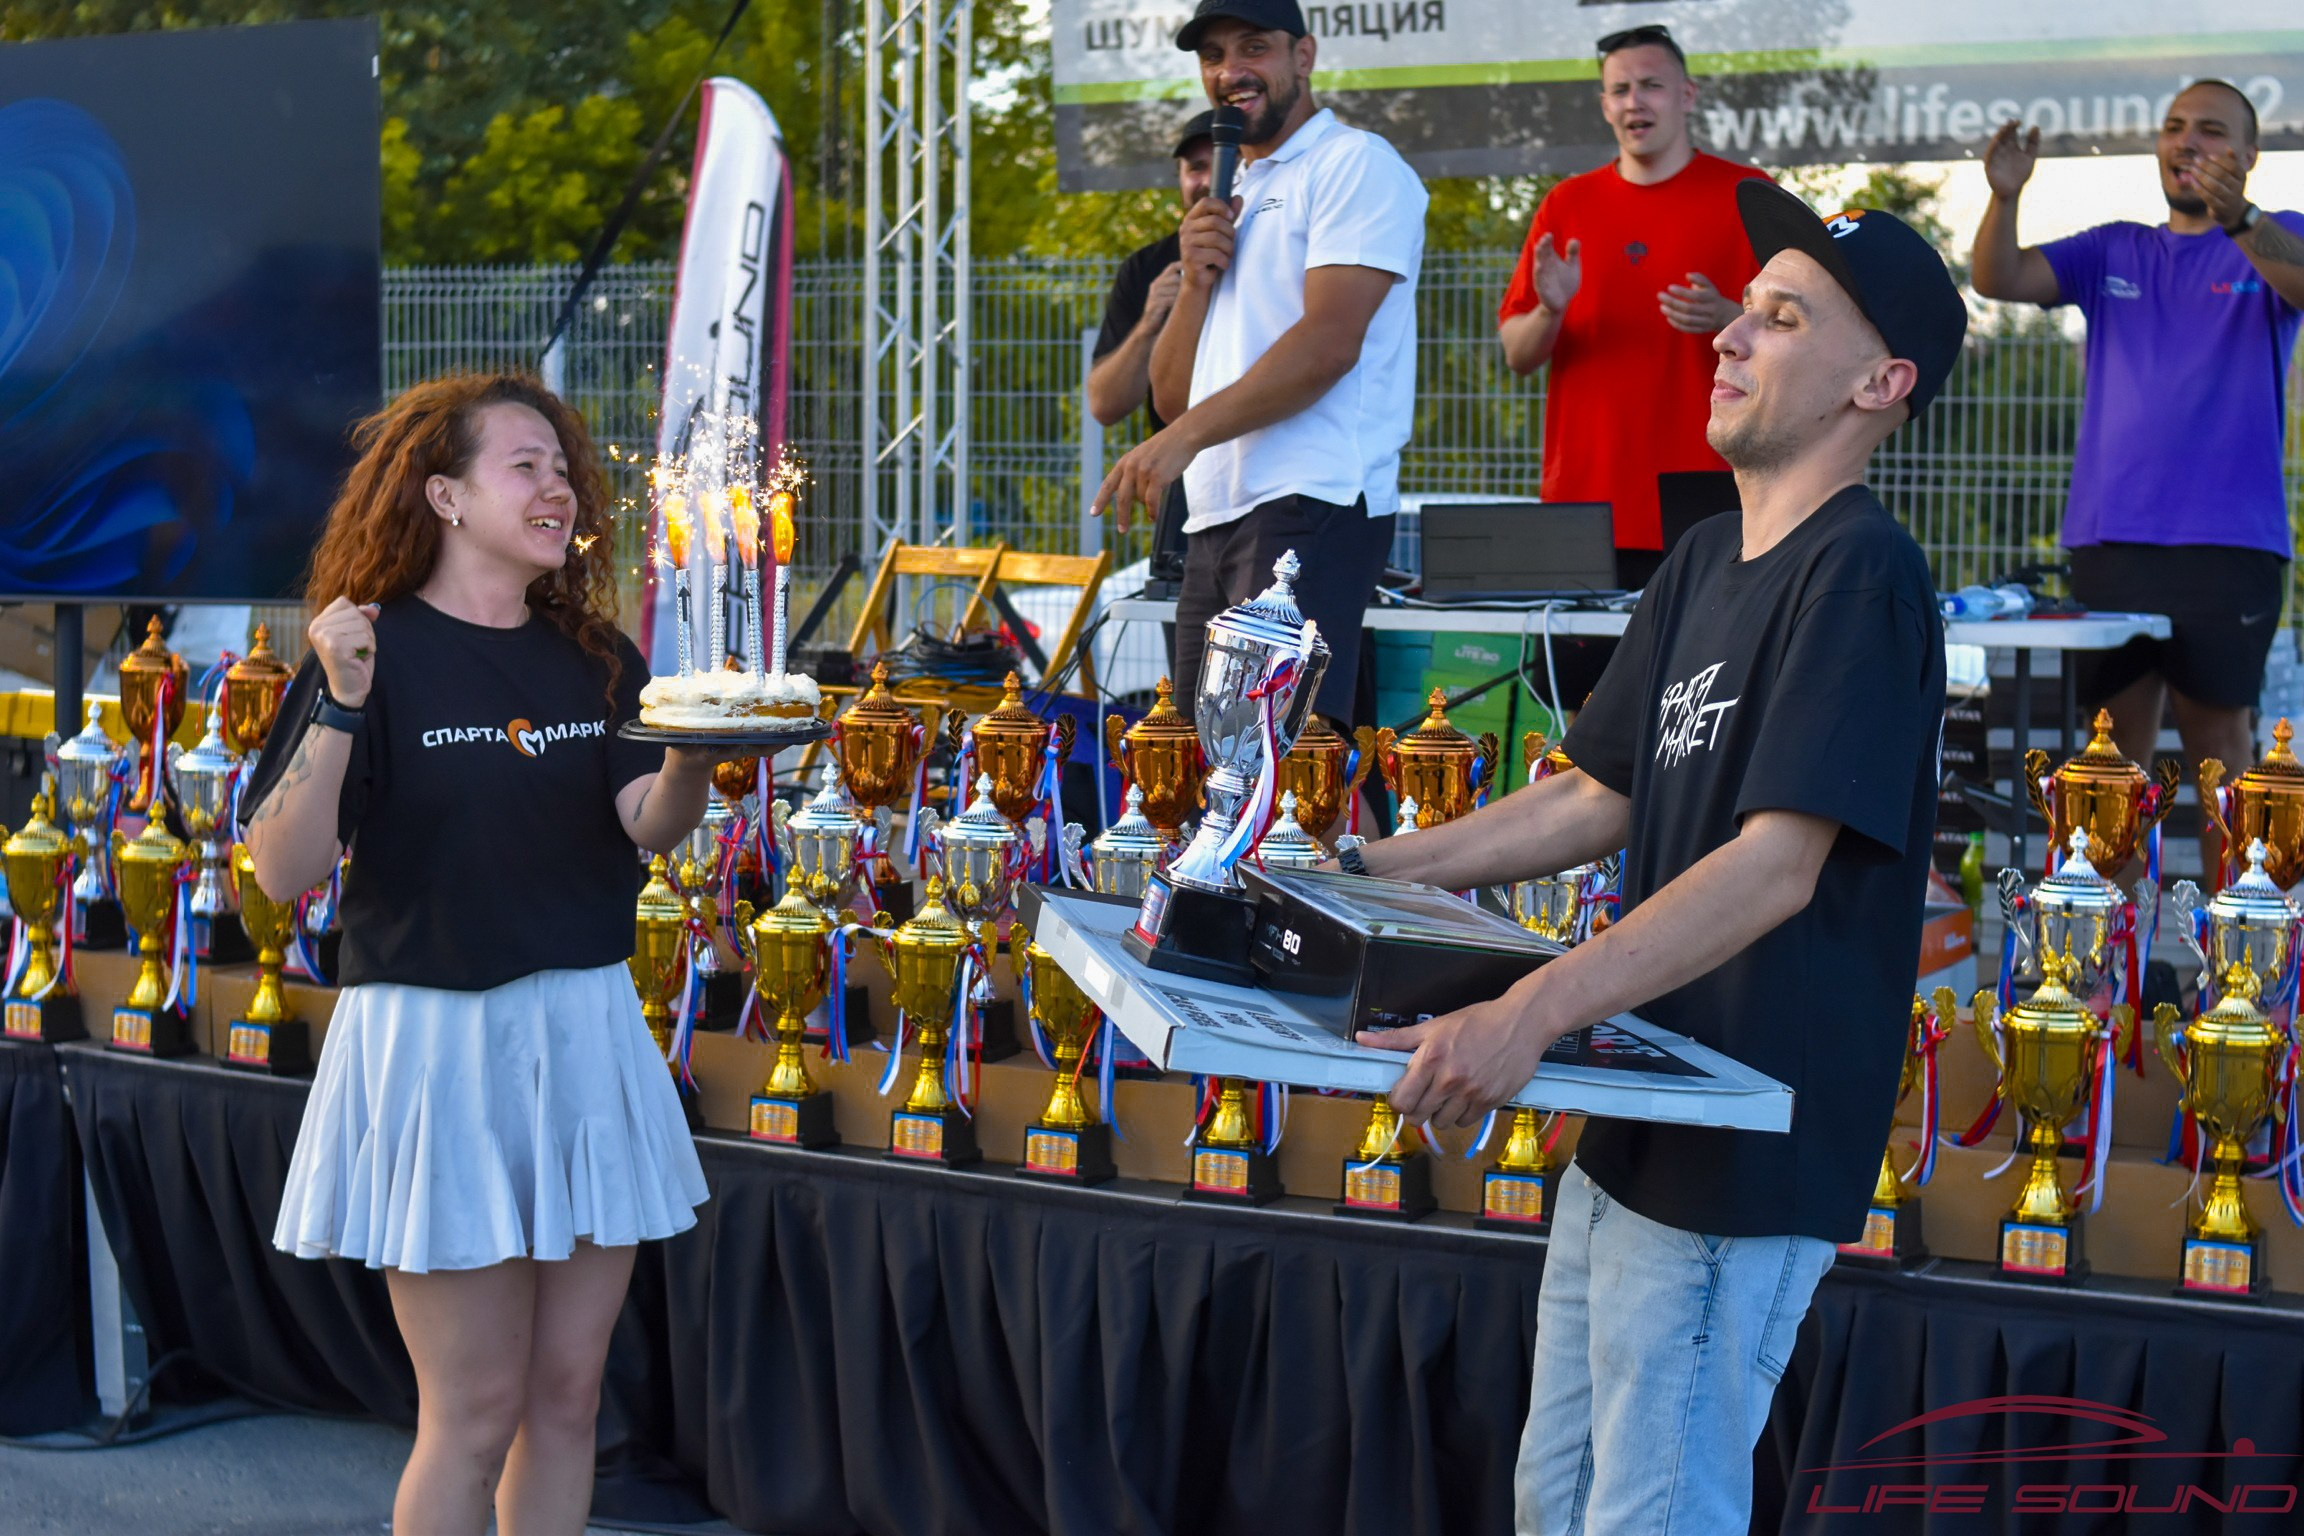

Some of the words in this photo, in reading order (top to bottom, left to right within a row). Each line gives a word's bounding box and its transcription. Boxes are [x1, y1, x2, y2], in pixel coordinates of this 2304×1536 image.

[1086, 0, 1445, 51] ШУМЛЯЦИЯ
[422, 727, 510, 748] СПАРТА
[1283, 929, 1301, 955] 80
